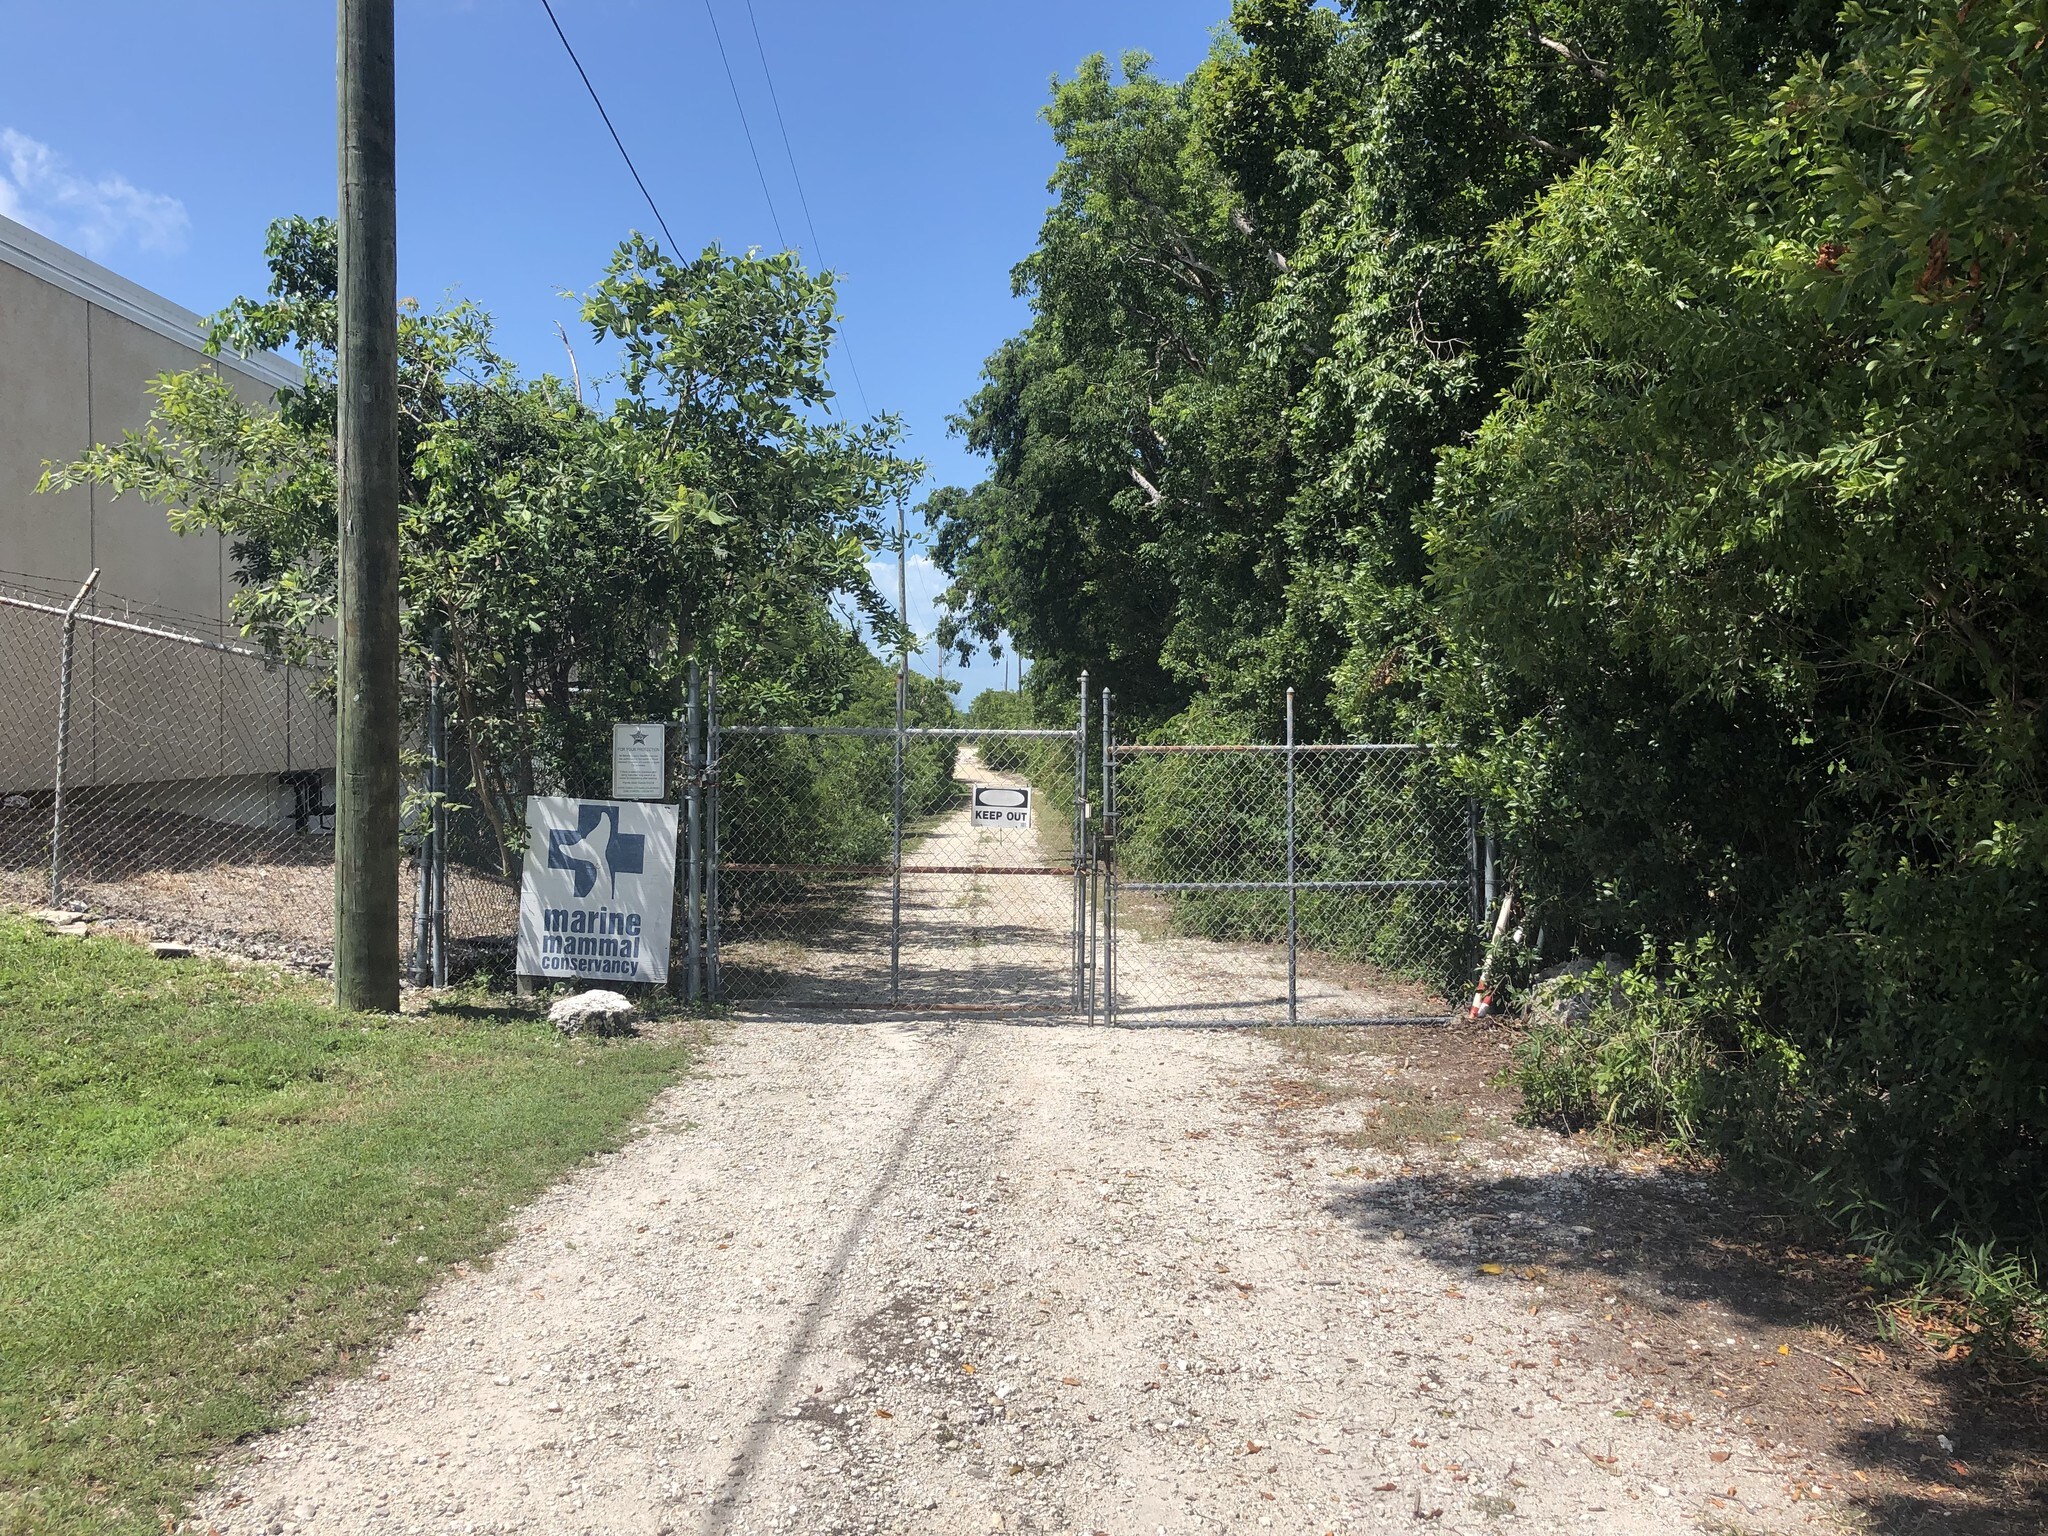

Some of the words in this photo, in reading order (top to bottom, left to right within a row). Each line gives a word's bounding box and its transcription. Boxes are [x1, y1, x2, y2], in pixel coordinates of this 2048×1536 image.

[975, 810, 1003, 820] KEEP
[1006, 811, 1027, 822] OUT
[544, 906, 641, 936] marine
[542, 935, 640, 958] mammal
[541, 956, 638, 976] conservancy
